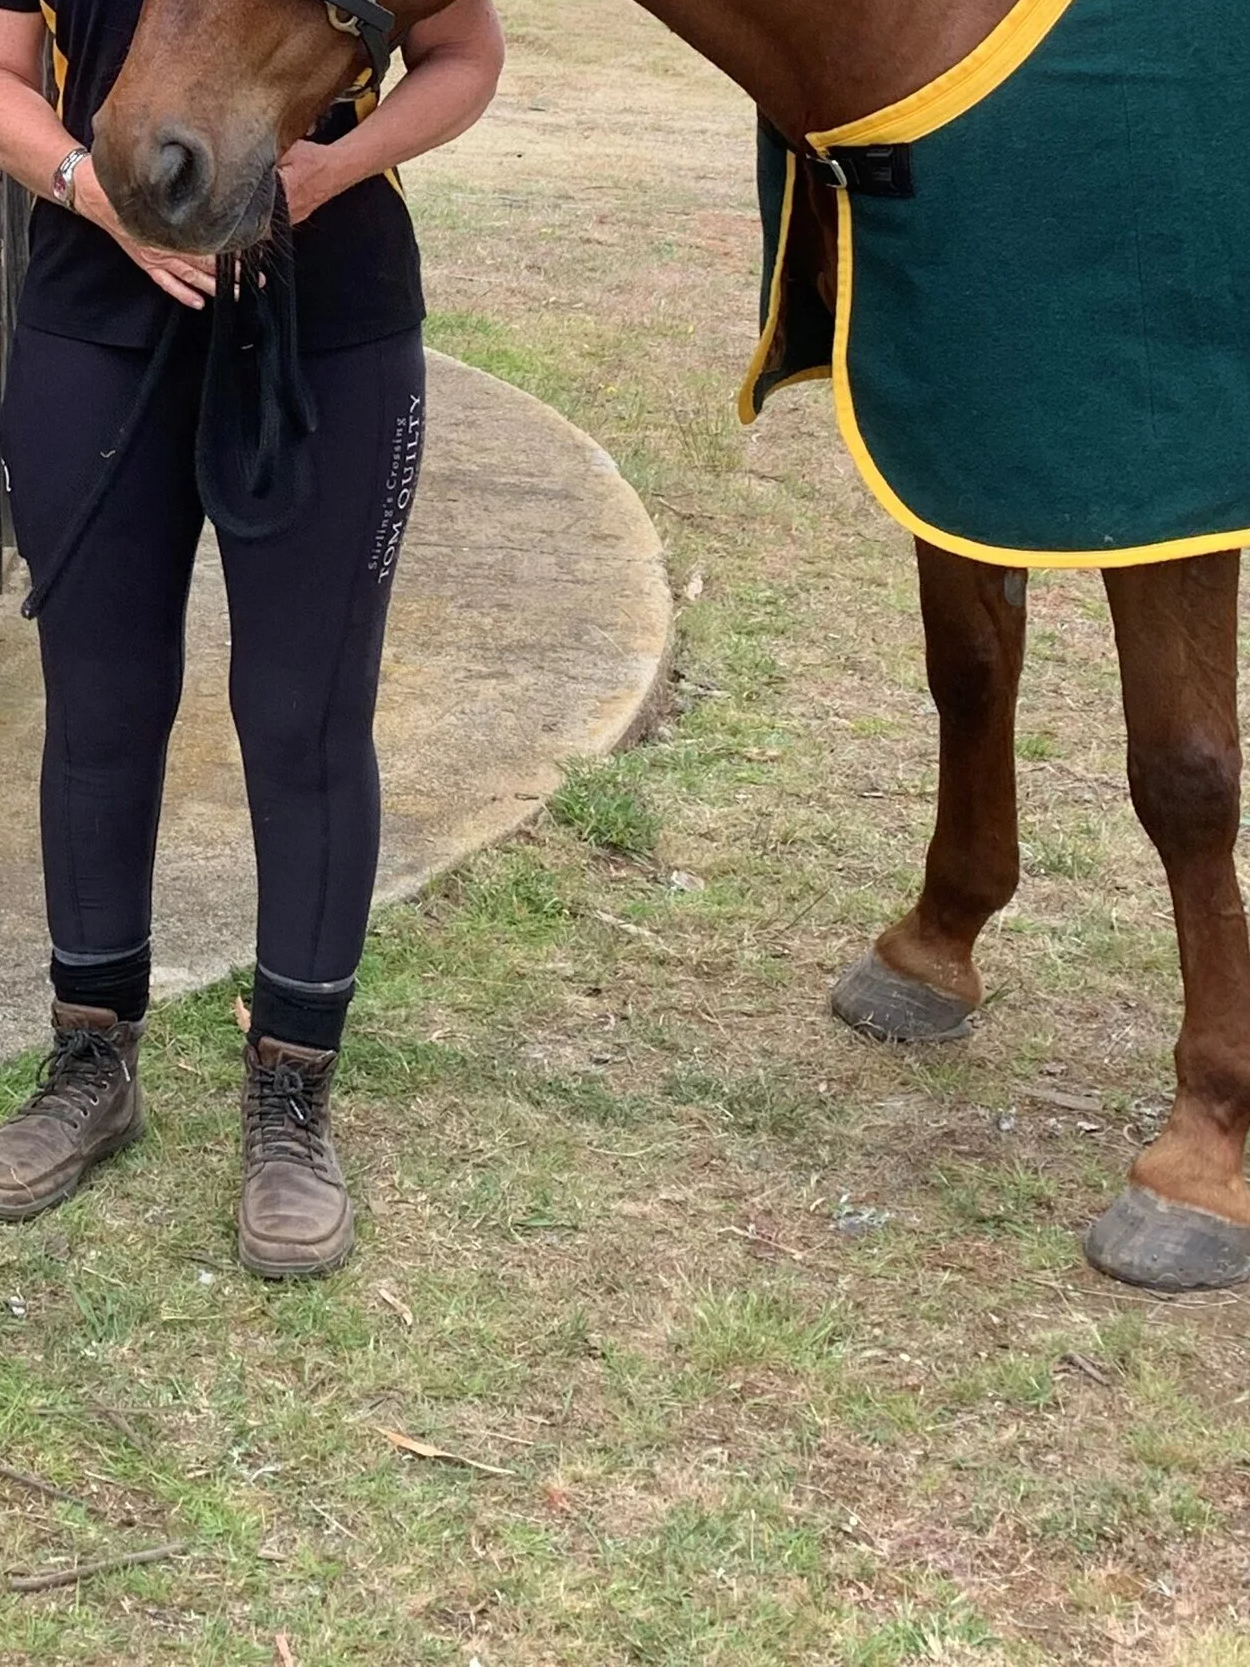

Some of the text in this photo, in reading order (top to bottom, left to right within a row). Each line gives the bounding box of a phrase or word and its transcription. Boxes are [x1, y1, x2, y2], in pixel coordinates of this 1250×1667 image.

[368, 417, 406, 570] Stirling's Crossing
[378, 521, 403, 583] TOM
